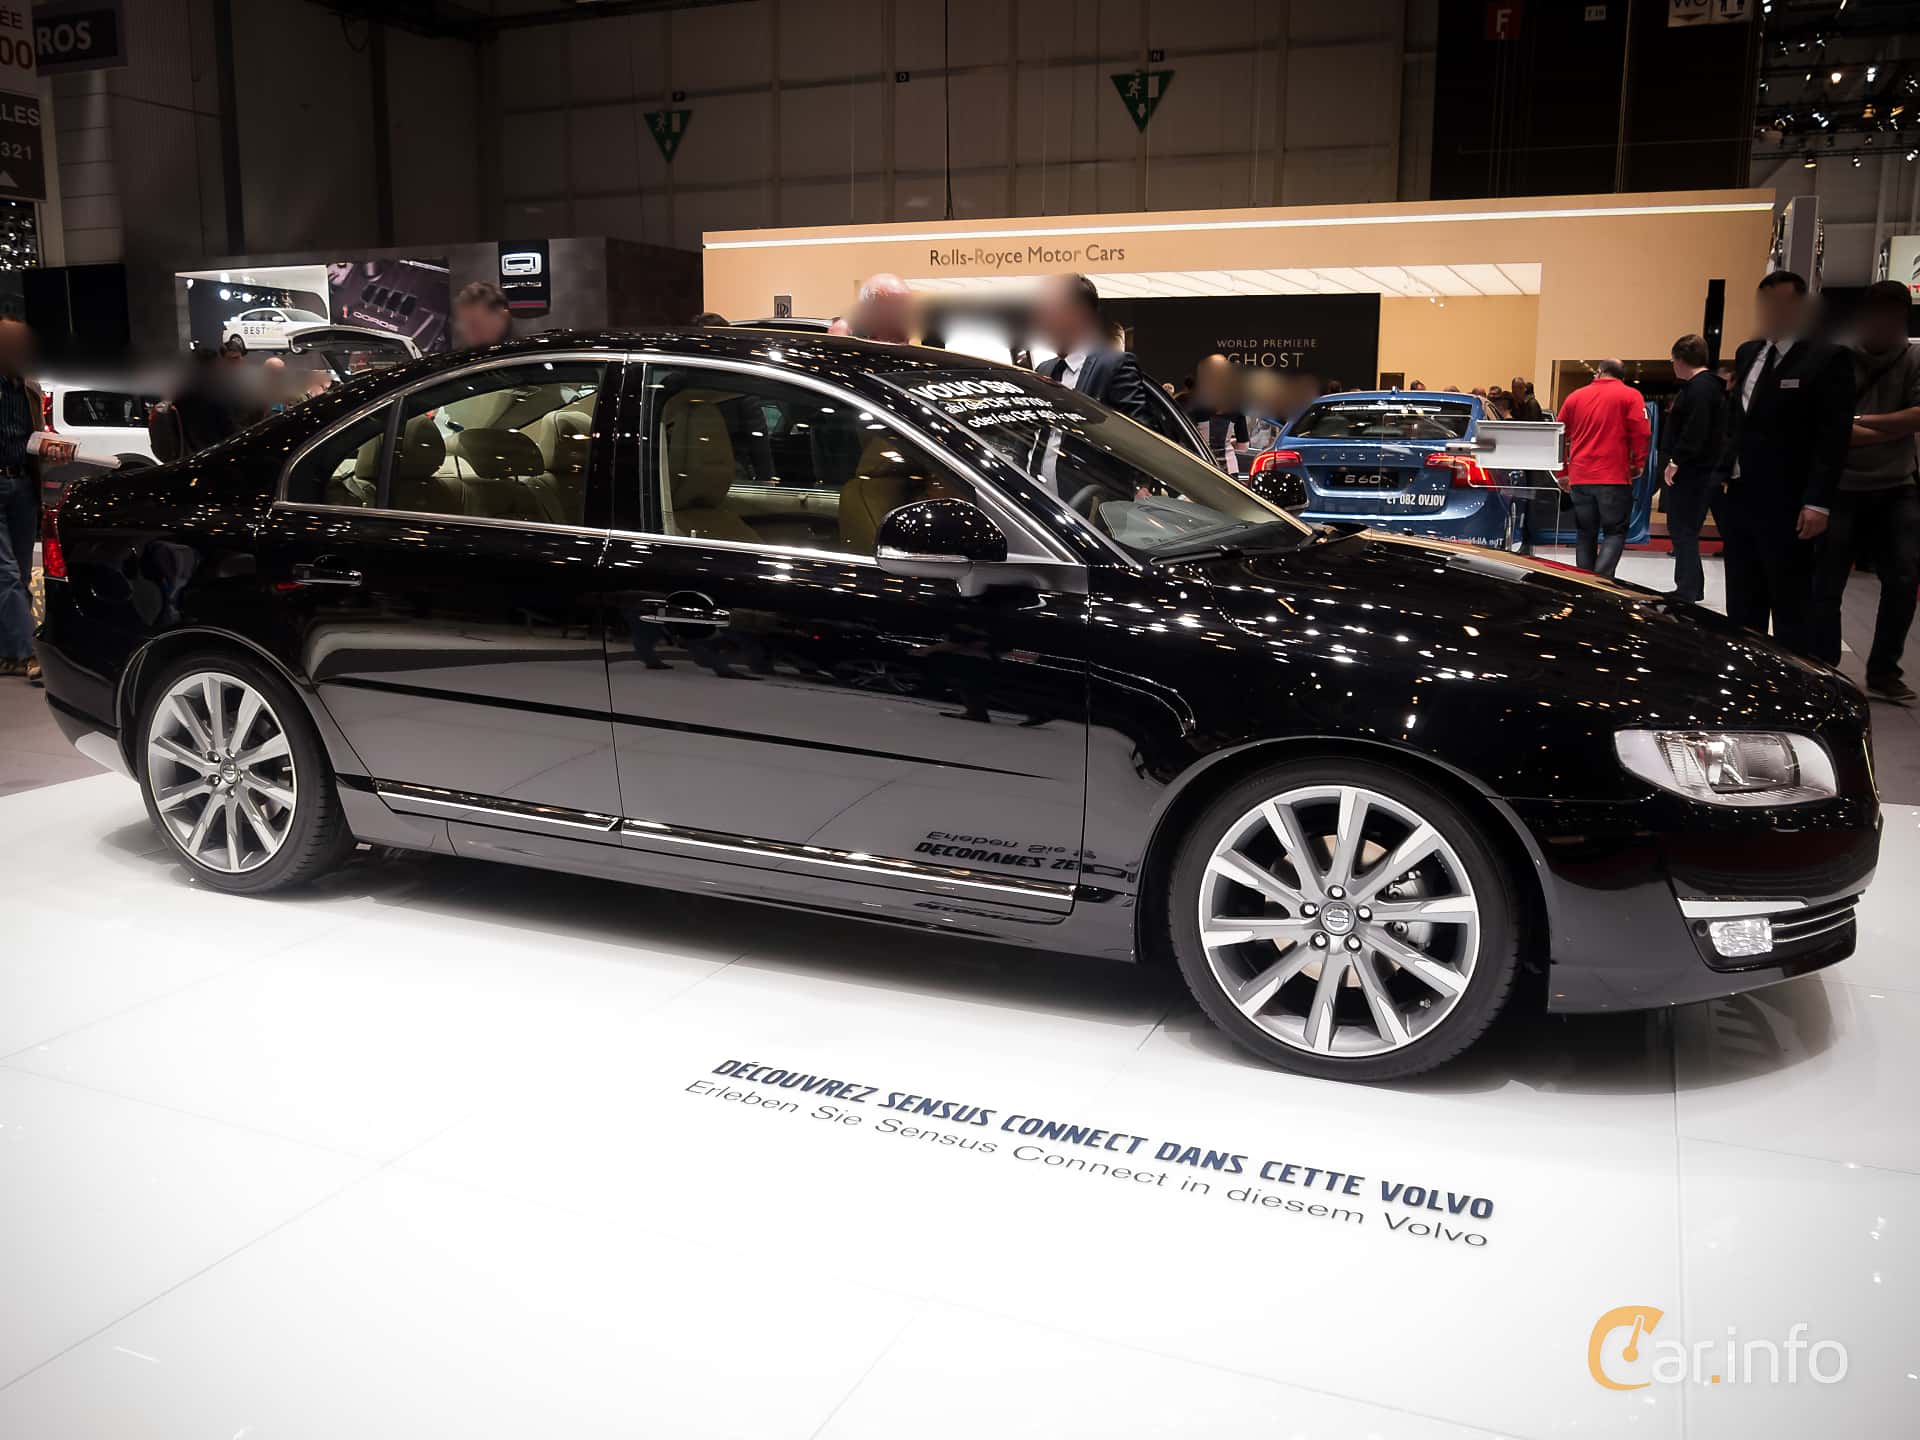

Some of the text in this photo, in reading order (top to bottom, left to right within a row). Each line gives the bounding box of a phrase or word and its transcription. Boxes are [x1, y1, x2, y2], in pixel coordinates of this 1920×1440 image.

[1496, 8, 1513, 40] F
[929, 244, 1126, 269] Rolls-Royce Motor Cars
[1216, 338, 1319, 349] WORLD PREMIERE
[908, 380, 988, 401] VOLVO
[711, 1059, 1495, 1220] DÉCOUVREZ SENSUS CONNECT DANS CETTE VOLVO
[684, 1079, 1488, 1247] Erleben Sie Sensus Connect in diesem Volvo
